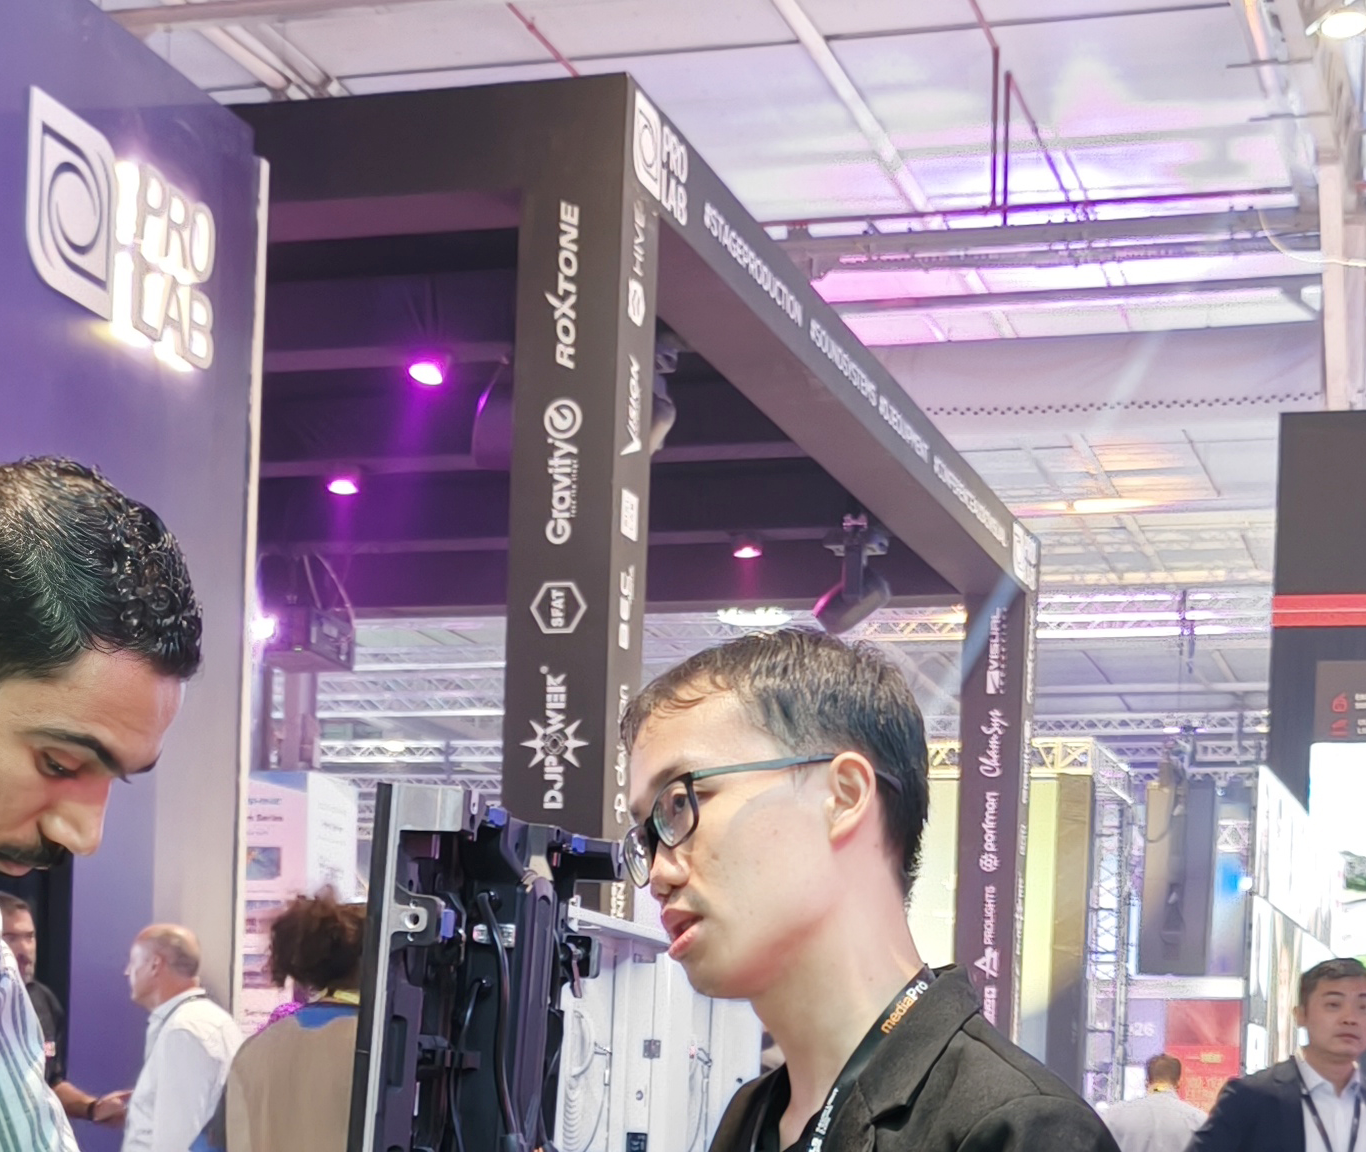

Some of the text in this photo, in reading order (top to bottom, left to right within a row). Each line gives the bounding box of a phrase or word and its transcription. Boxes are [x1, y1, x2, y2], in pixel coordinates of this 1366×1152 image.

[662, 168, 687, 226] LAB
[663, 124, 687, 184] PRO
[137, 162, 216, 284] PRO
[704, 201, 804, 328] #STAGEPRODUCTION
[132, 256, 214, 369] LAB
[545, 200, 580, 370] ROXTONE
[546, 439, 580, 545] Gravity
[880, 979, 929, 1034] mediaPro
